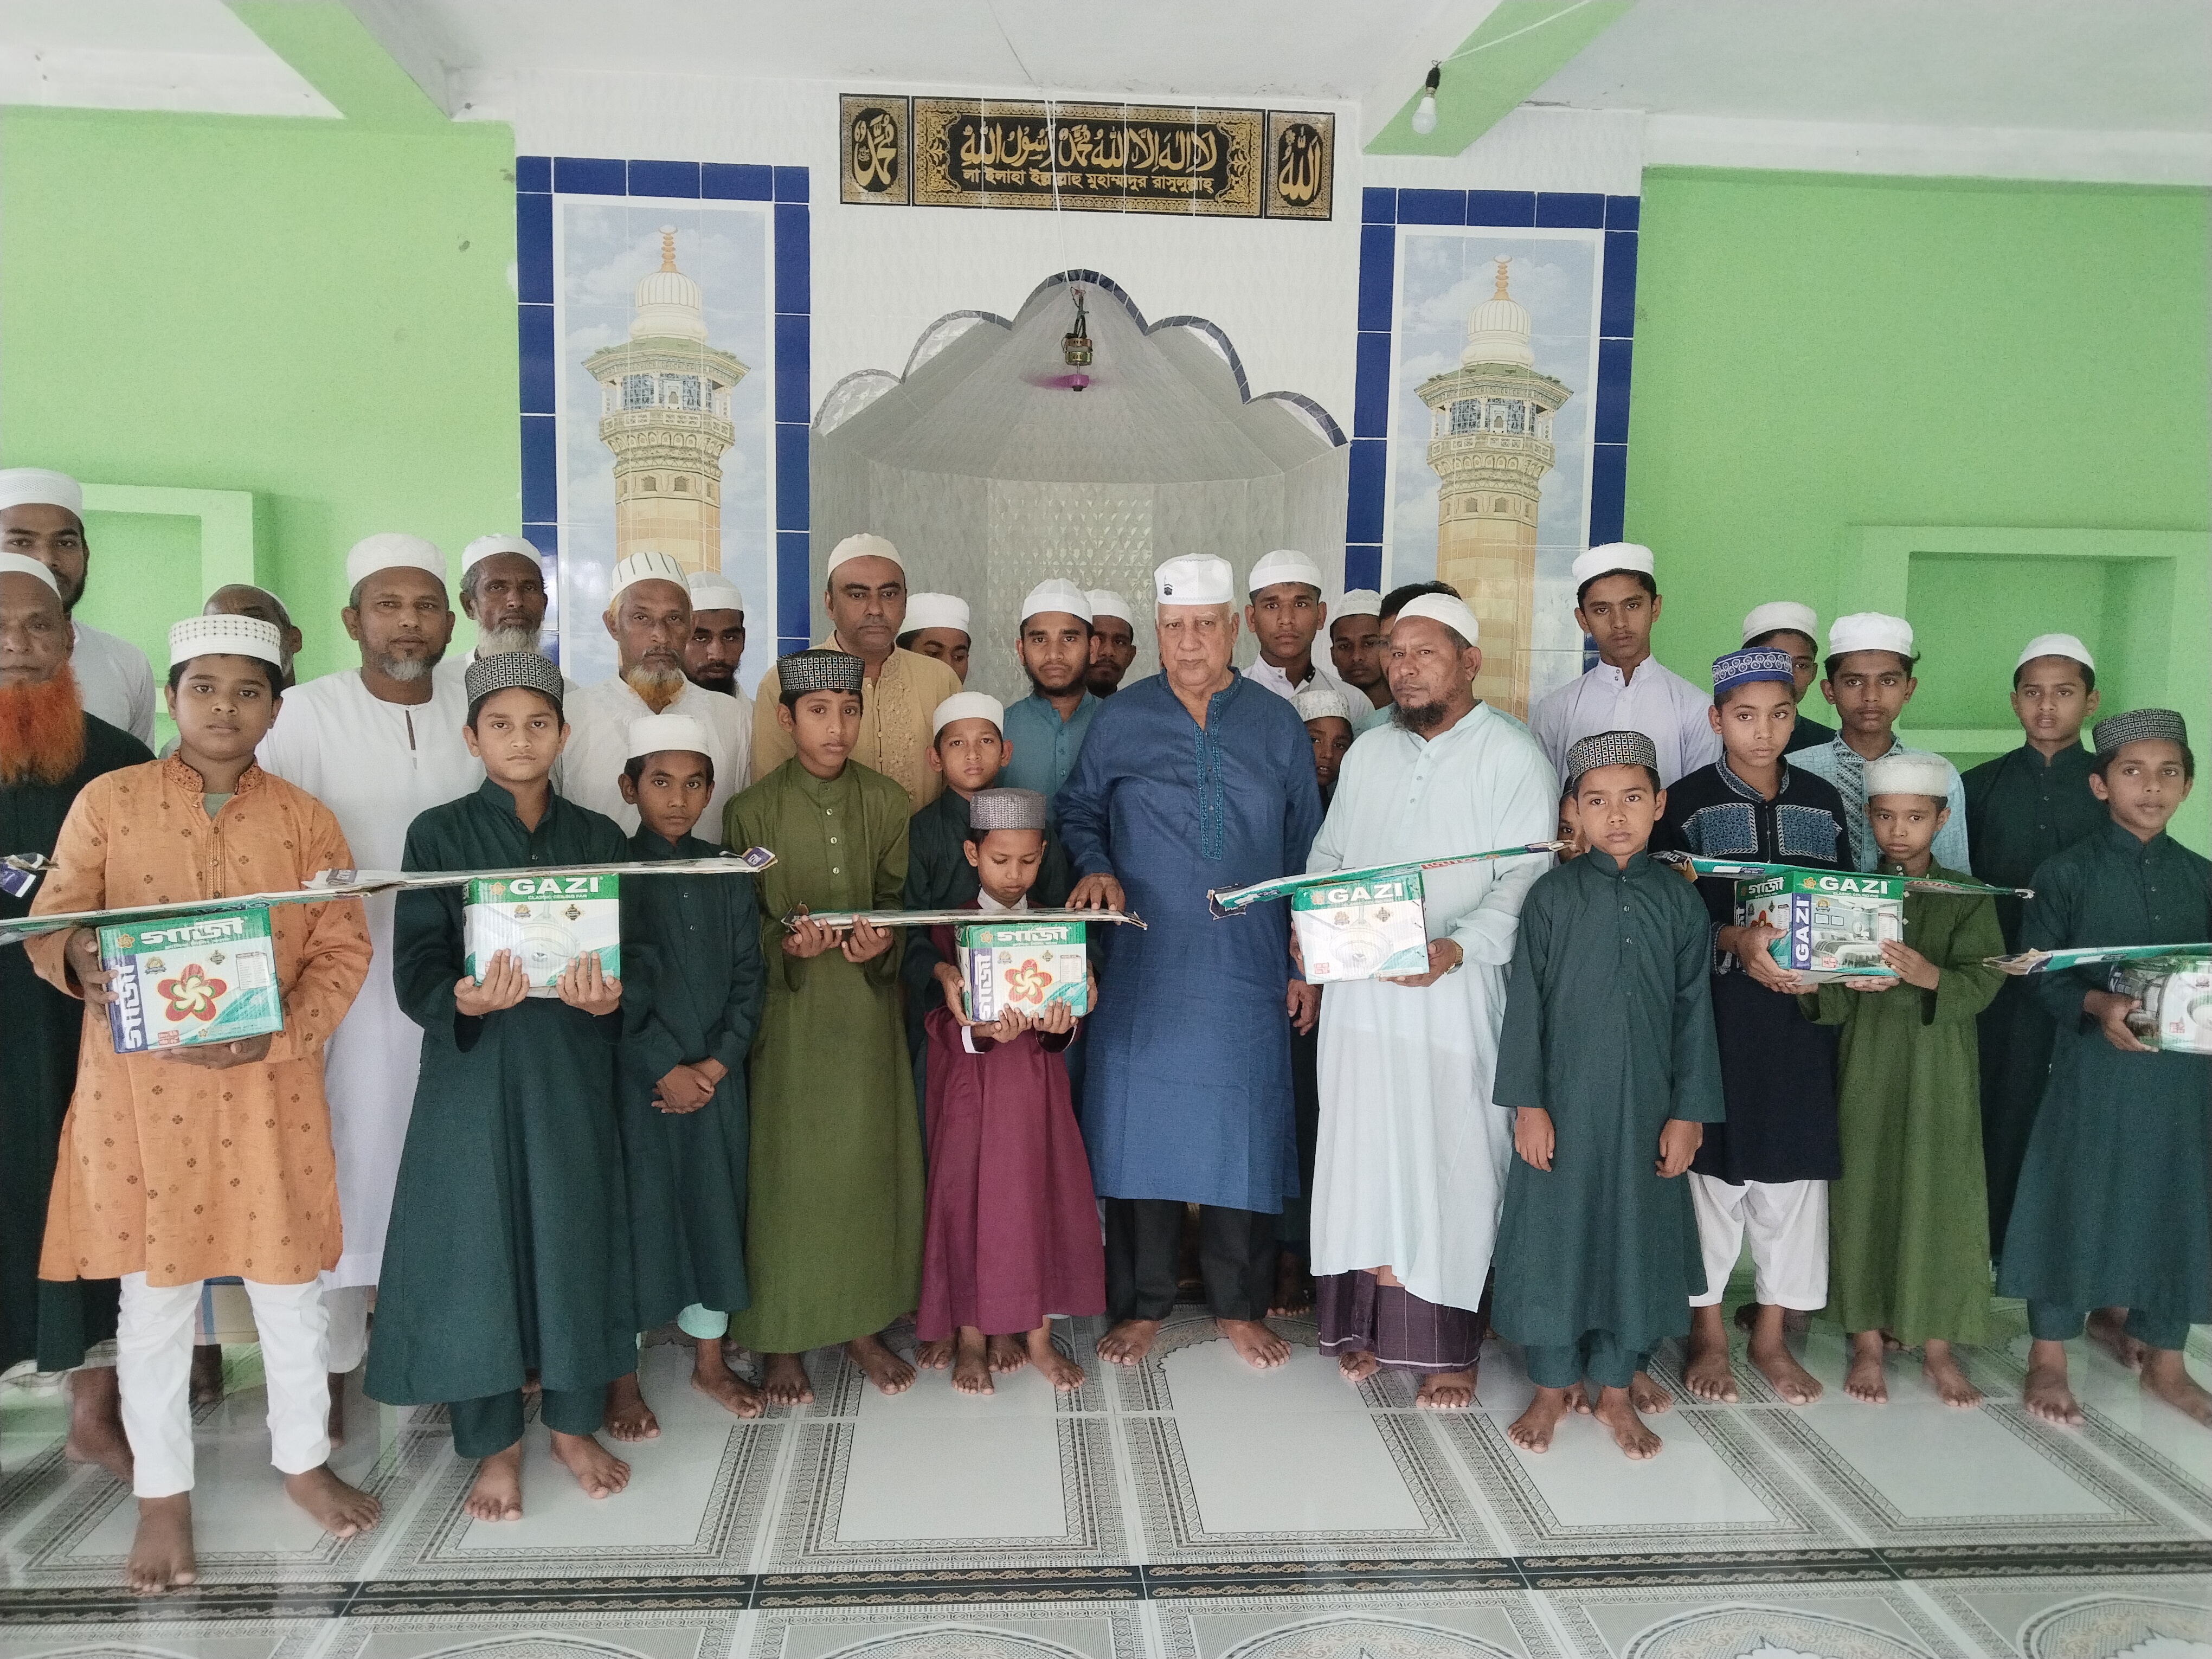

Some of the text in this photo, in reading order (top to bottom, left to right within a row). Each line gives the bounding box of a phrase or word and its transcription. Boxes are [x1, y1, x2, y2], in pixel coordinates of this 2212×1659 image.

[962, 168, 981, 183] লা
[984, 165, 1027, 185] ইলাহা
[510, 877, 599, 895] GAZI
[1328, 882, 1403, 903] GAZI
[1748, 877, 1784, 894] গাজী
[1819, 876, 1888, 895] GAZI
[140, 917, 245, 944] গাজী
[996, 926, 1069, 942] গাজী
[1796, 900, 1809, 961] GAZI
[974, 954, 994, 1021] গাজী
[112, 964, 143, 1049] গাজী
